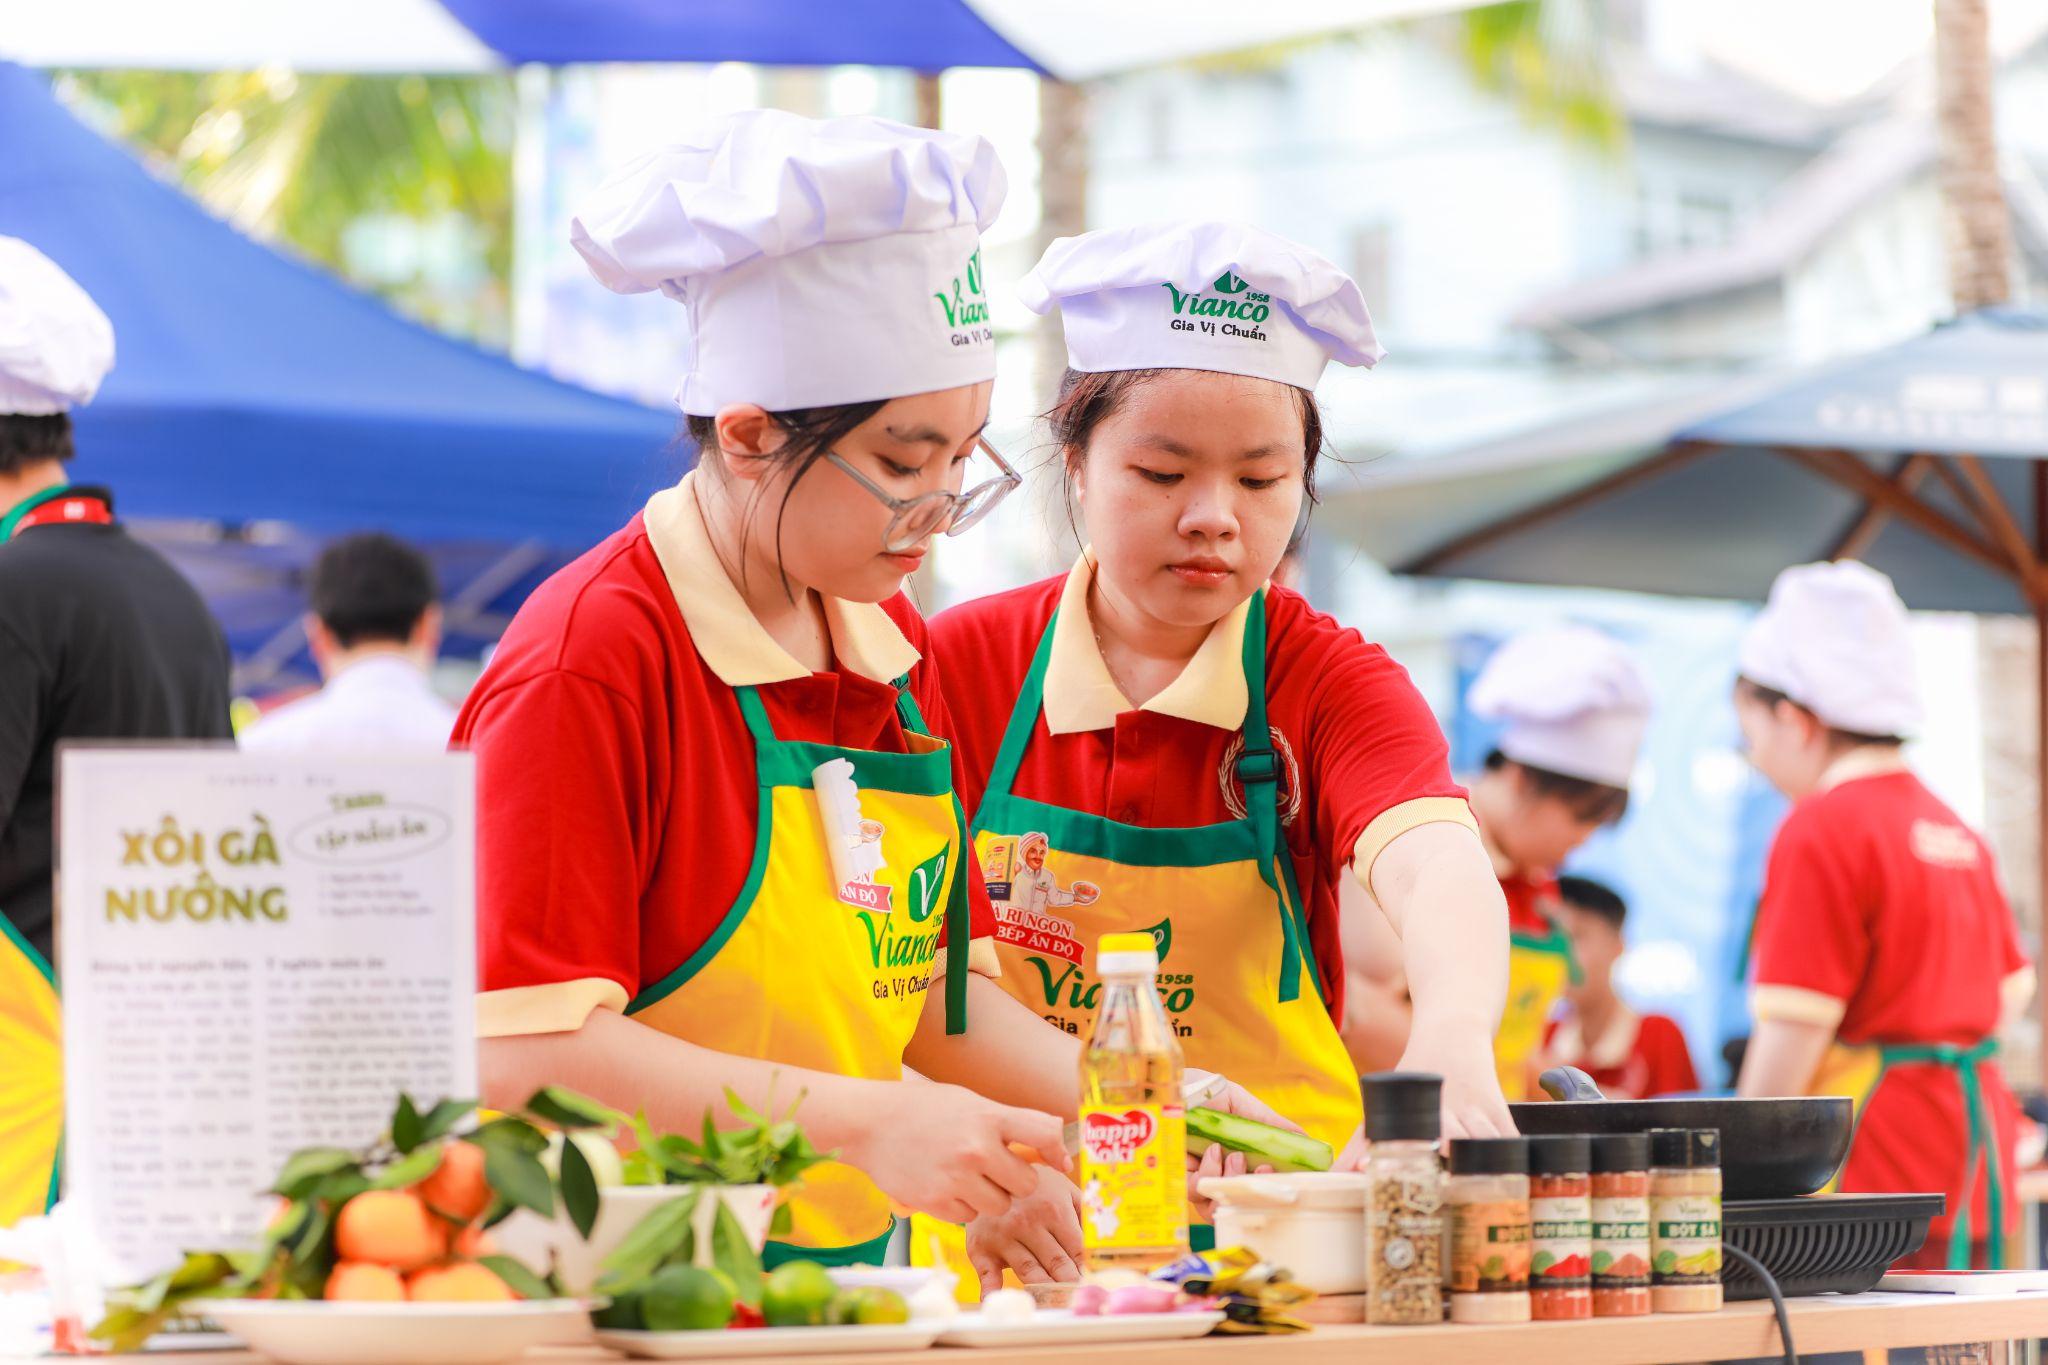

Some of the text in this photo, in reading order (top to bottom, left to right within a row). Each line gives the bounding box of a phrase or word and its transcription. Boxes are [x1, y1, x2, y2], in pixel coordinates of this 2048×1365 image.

[1162, 282, 1270, 323] Vianco
[1244, 292, 1271, 303] 1958
[951, 333, 970, 346] Gia
[1170, 319, 1267, 341] Gia Vị Chuẩn
[121, 814, 205, 867] XÔI
[218, 812, 281, 867] GÀ
[104, 870, 288, 923] NƯỚNG
[1006, 908, 1022, 923] RI
[1026, 912, 1072, 938] NGON
[997, 925, 1075, 958] BẾP ẤN ĐỘ
[873, 980, 888, 998] Gia
[893, 978, 905, 1001] Vị
[1156, 974, 1194, 984] 1958
